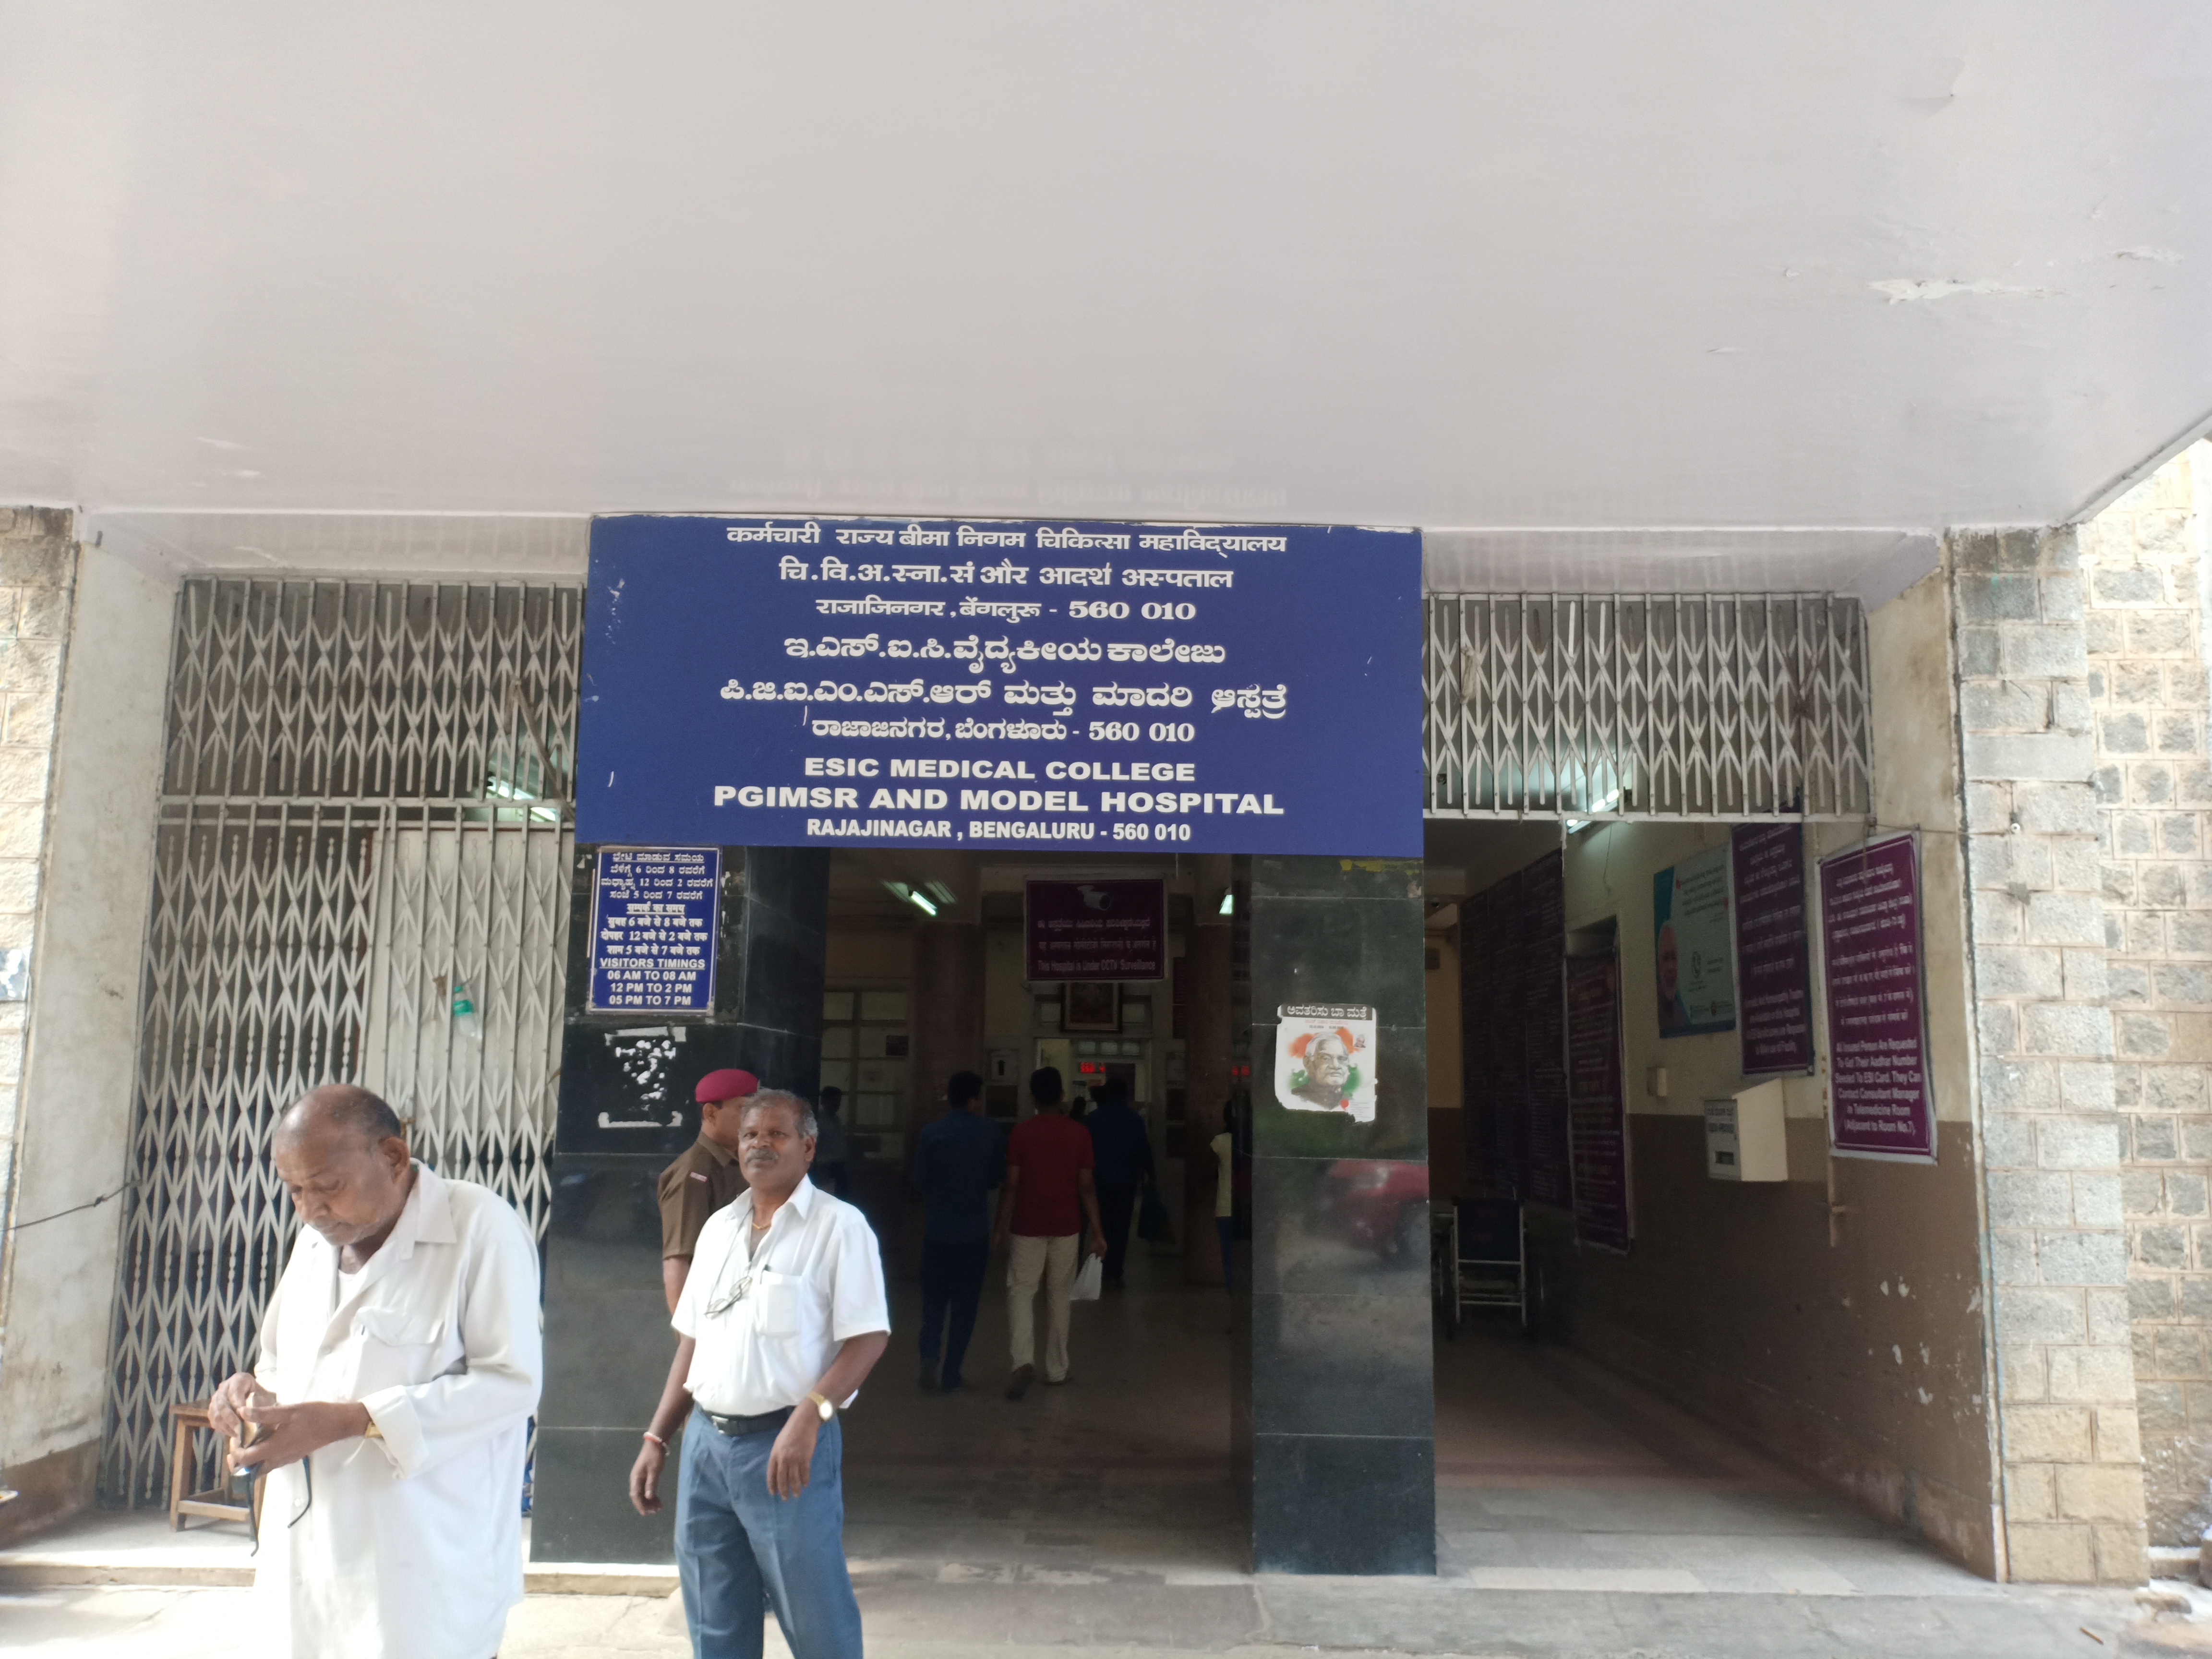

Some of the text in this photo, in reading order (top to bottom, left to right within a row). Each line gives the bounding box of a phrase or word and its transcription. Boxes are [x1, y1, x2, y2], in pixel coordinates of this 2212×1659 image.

[727, 522, 821, 543] कर्मचारी
[836, 529, 894, 544] राज्य
[899, 524, 950, 546] बीमा
[957, 525, 1026, 547] निगम
[1035, 527, 1130, 549] चिकित्सा
[980, 558, 1029, 584] और
[1122, 569, 1233, 587] अस्पताल
[816, 595, 946, 615] राजाजिनगर
[1070, 601, 1129, 618] 560
[1142, 603, 1195, 619] 010
[1107, 638, 1225, 662] ಕಾಲೇಜು
[1004, 681, 1076, 716] ಮತ್ತು
[1093, 682, 1192, 707] ಮಾದರಿ
[955, 718, 1066, 739] ಬೆಂಗಳೂರು
[1089, 722, 1139, 741] 560
[1149, 723, 1194, 741] 010
[805, 758, 1194, 781] ESIC MEDICAL COLLEGE
[715, 786, 1284, 814] PGIMSR AND MODEL HOSPITAL
[807, 819, 951, 837] RAJAJINAGAR
[970, 821, 1094, 839] BENGALURU
[1113, 823, 1148, 840] 560
[1155, 824, 1190, 840] 010
[636, 865, 642, 873] 6
[669, 865, 675, 874] 8
[639, 878, 650, 886] 12
[677, 878, 683, 887] 2
[633, 890, 639, 899] 5
[666, 891, 673, 900] 7
[652, 904, 664, 912] का
[665, 904, 685, 912] समय
[608, 915, 703, 928] सुबह 6 बजे से 8 बजे तक
[600, 928, 708, 941] दोपहर 12 बजे से 2 बजे तक
[606, 943, 700, 955] शाम 5 बजे से 7 बजे तक
[600, 958, 705, 968] VISITORS TIMINGS
[1101, 959, 1118, 970] CCTV
[607, 970, 696, 980] 06 AM TO 08 AM
[610, 983, 692, 993] 12 PM TO 2 PM
[609, 995, 691, 1005] 05 PM TO 7 PM
